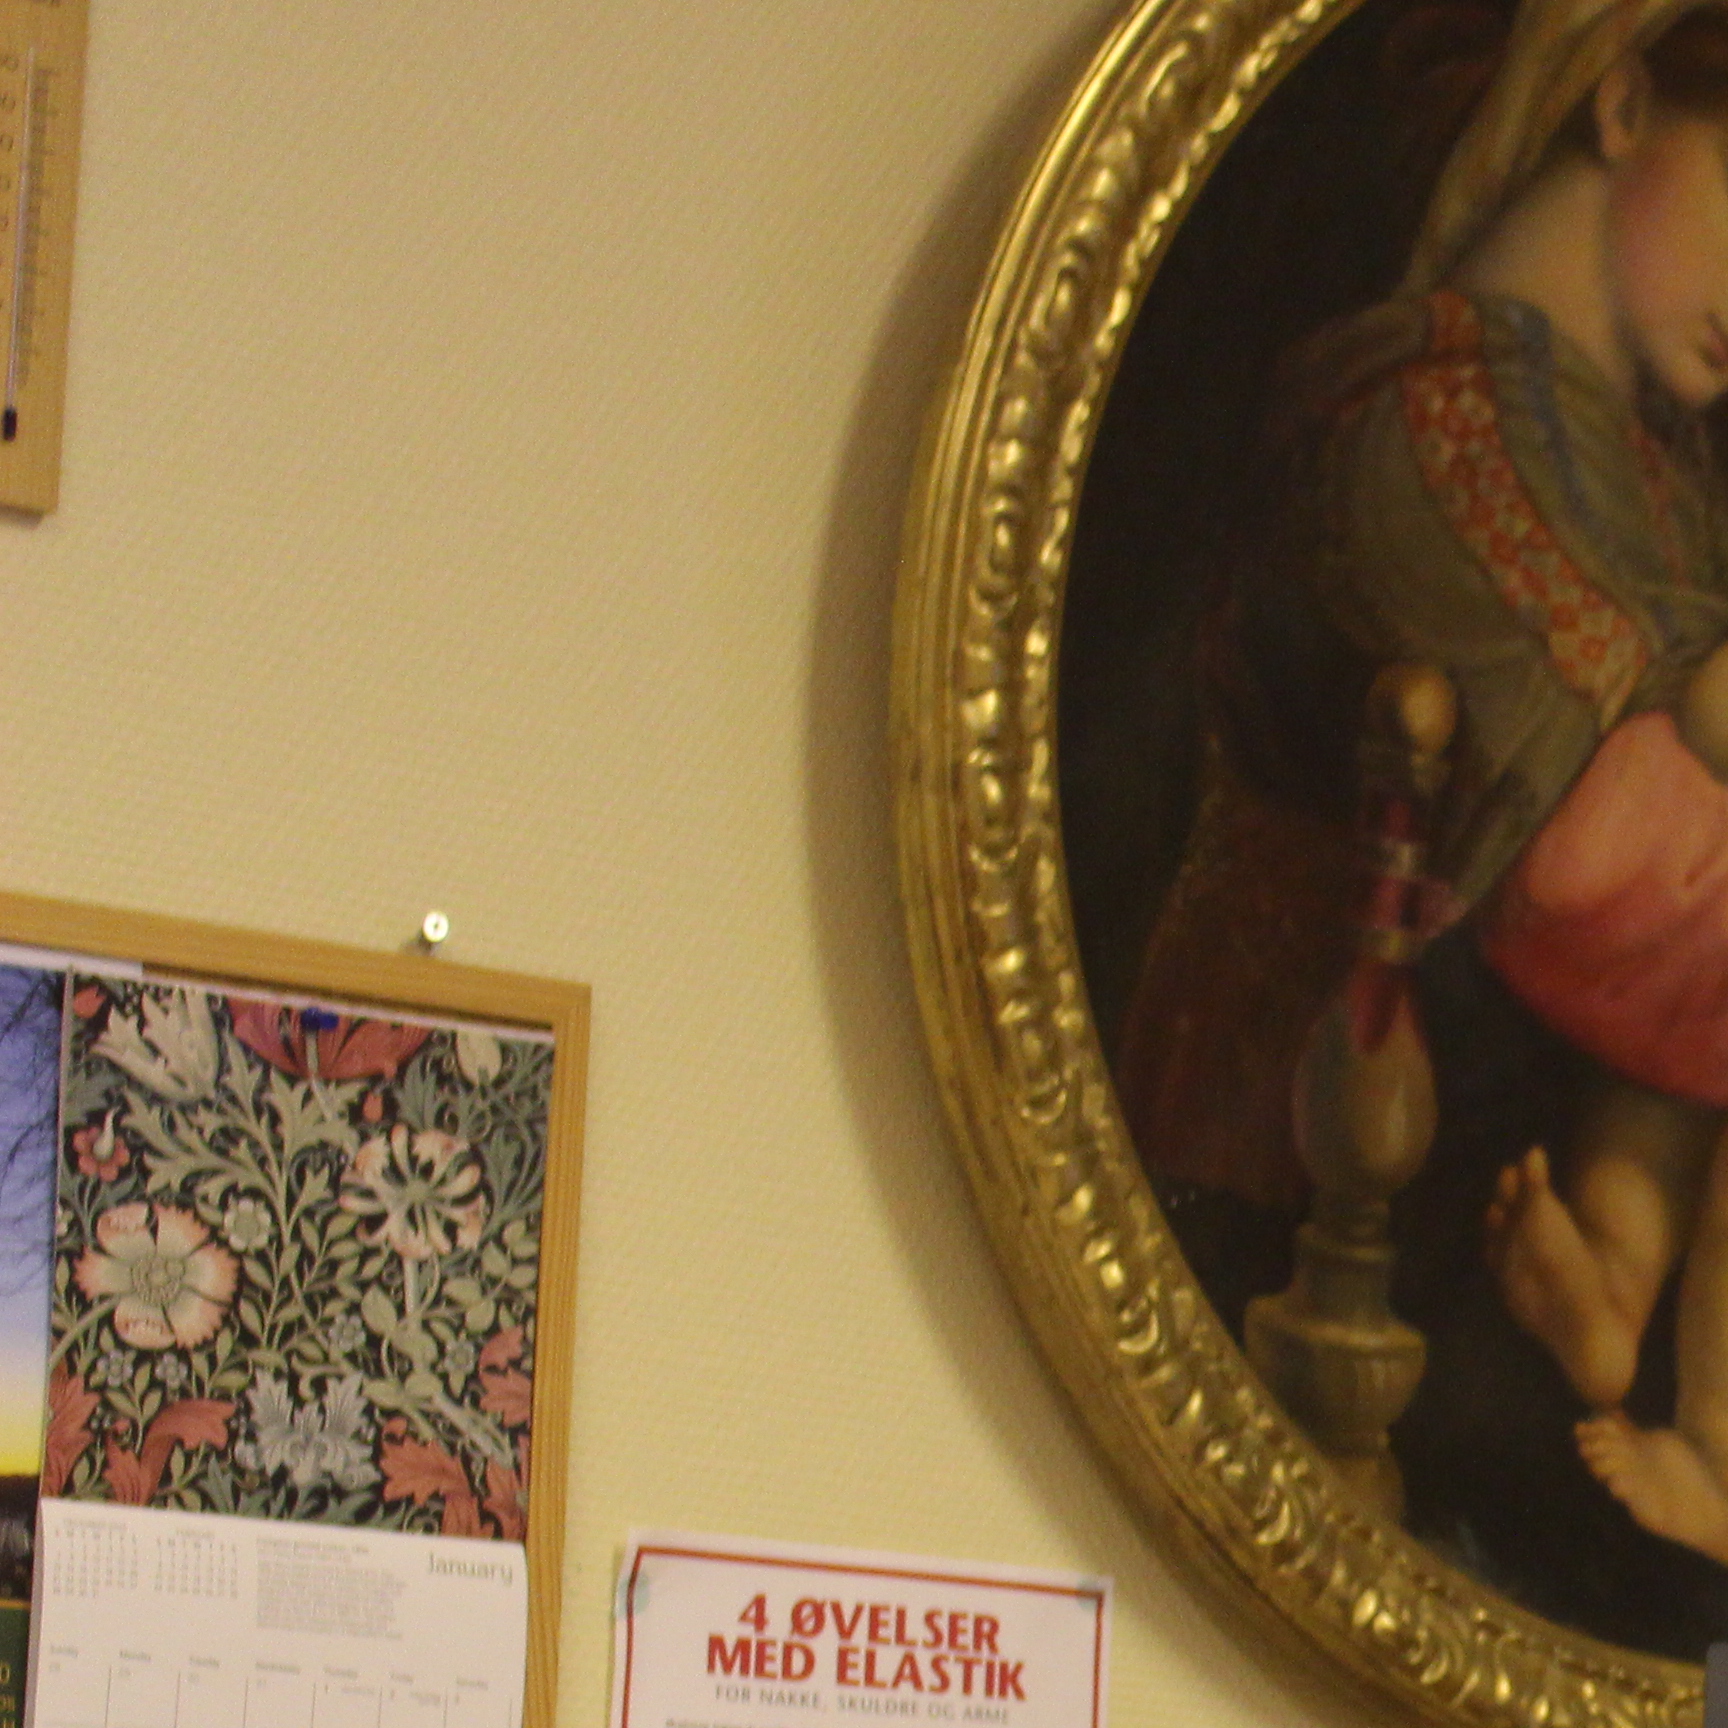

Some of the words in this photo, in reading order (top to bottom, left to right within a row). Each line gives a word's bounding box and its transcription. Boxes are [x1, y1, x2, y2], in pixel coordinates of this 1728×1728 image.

[428, 1551, 513, 1588] January
[738, 1593, 768, 1633] 4
[790, 1596, 1001, 1654] ØVELSER
[706, 1633, 816, 1683] MED
[836, 1645, 1027, 1701] ELASTIK
[714, 1685, 752, 1702] FOR
[928, 1701, 955, 1721] OG
